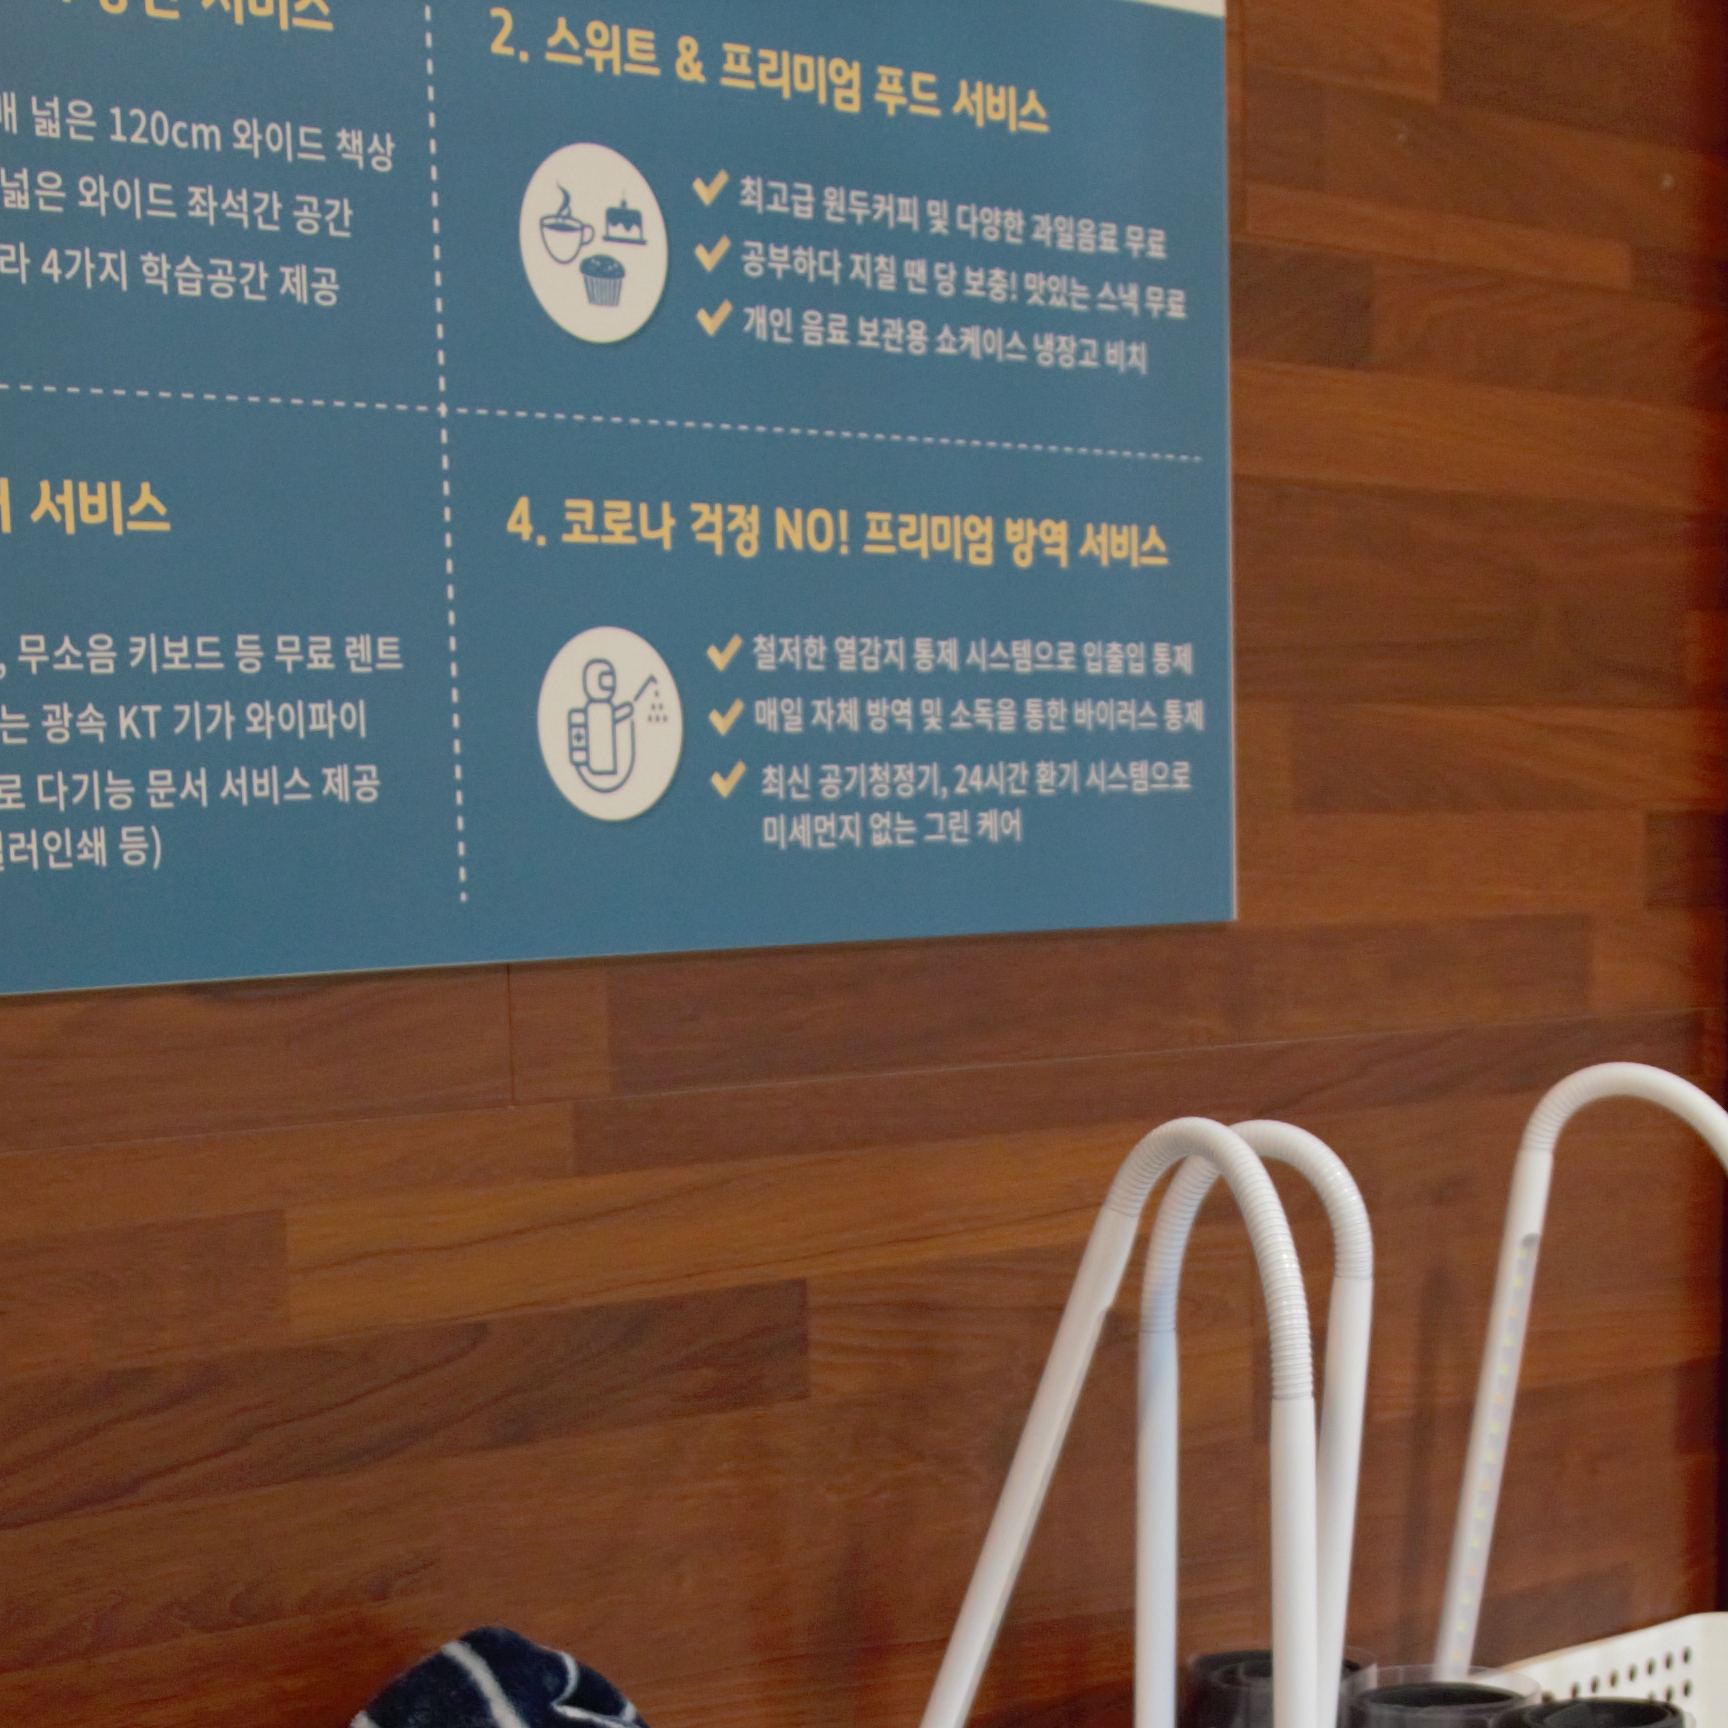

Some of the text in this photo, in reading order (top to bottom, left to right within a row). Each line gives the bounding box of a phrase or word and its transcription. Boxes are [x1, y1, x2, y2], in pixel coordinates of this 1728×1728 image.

[490, 8, 1050, 134] 2. 스위트 & 프리미엄 푸드 서비스
[30, 96, 96, 141] 넓은
[109, 106, 221, 151] 120cm
[232, 118, 325, 162] 와이드
[336, 129, 395, 173] 책상
[0, 167, 66, 211] 넓은
[78, 175, 176, 218] 와이드
[188, 184, 282, 229] 좌석간
[293, 194, 353, 237] 공간
[740, 176, 1167, 259] 최고급 원두커피 및 다양한 과일음료 무료
[42, 247, 127, 290] 4가지
[141, 251, 268, 300] 학습공간
[280, 263, 339, 305] 제공
[742, 240, 841, 285] 공부하다
[849, 253, 896, 291] 지칠
[934, 262, 957, 297] 당
[1024, 272, 1090, 312] 맛있는
[1145, 286, 1187, 318] 무료
[744, 305, 1147, 375] 개인 음료 보관용 쇼케이스 냉장고 비치
[30, 479, 170, 535] 서비스
[506, 496, 1168, 568] 4. 코로나 걱정 NO! 프리미엄 방역 서비스
[18, 633, 117, 674] 무소음
[129, 634, 224, 674] 키보드
[235, 634, 263, 673] 등
[275, 635, 336, 673] 무료
[345, 635, 403, 672] 렌트
[753, 634, 827, 671] 철저한
[834, 635, 905, 672] 열감지
[966, 637, 1077, 673] 시스템으로
[41, 702, 107, 744] 광속
[118, 705, 161, 739] KT
[173, 700, 235, 741] 기가
[245, 699, 367, 740] 와이파이
[755, 697, 803, 732] 매일
[811, 697, 859, 732] 자체
[866, 697, 913, 732] 방역
[921, 697, 942, 731] 및
[949, 698, 1017, 732] 소독을
[1024, 698, 1066, 731] 통한
[1074, 698, 1158, 731] 바이러스
[36, 769, 135, 812] 다기능
[146, 768, 209, 808] 문서
[220, 765, 312, 805] 서비스
[322, 763, 380, 803] 제공
[762, 759, 1192, 800] 최신 공기청정기, 24시간 환기 시스템으로
[118, 825, 163, 870] 등)
[763, 808, 1024, 849] 미세먼지 없는 그린 케어
